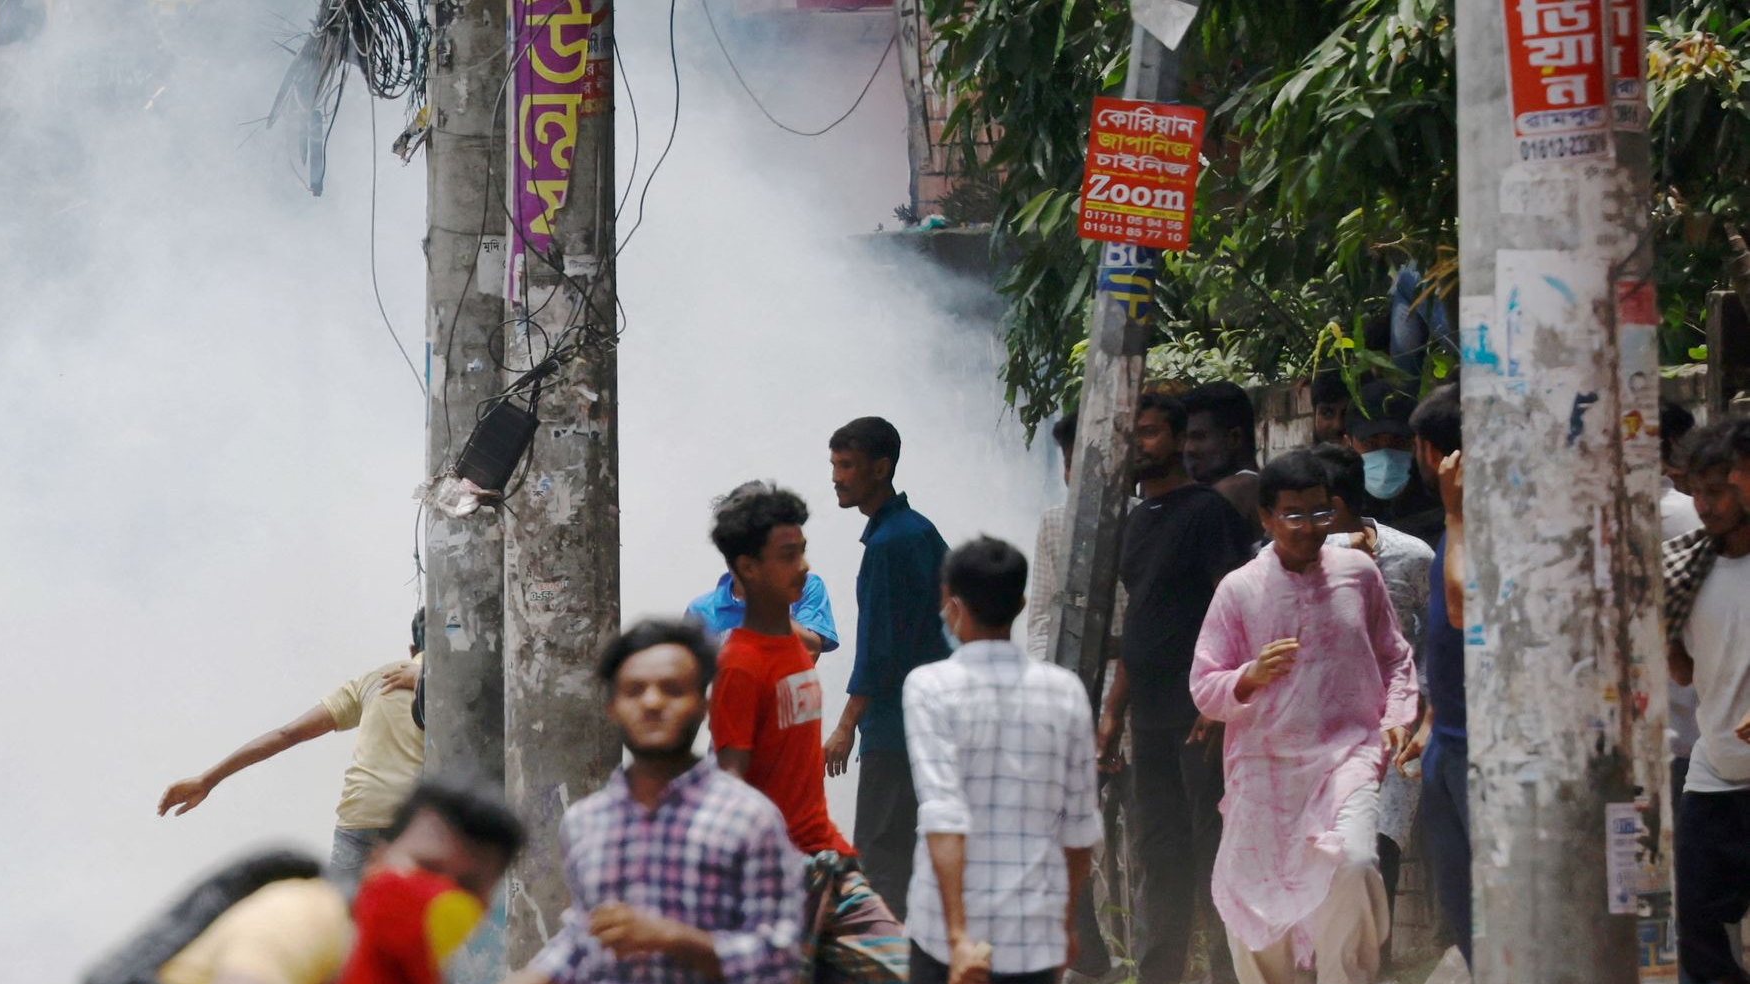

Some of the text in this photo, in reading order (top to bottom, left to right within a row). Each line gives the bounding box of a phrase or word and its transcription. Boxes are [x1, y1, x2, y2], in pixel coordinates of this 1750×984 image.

[1097, 107, 1197, 138] কোরিয়ান
[1096, 132, 1193, 159] জাপানিজ
[1094, 152, 1190, 176] চাইনিজ
[1087, 174, 1185, 210] Zoom
[1085, 210, 1122, 222] 01711
[1126, 215, 1143, 225] 05
[1084, 221, 1122, 234] 01912
[1146, 230, 1162, 239] 77
[1167, 233, 1182, 242] 10
